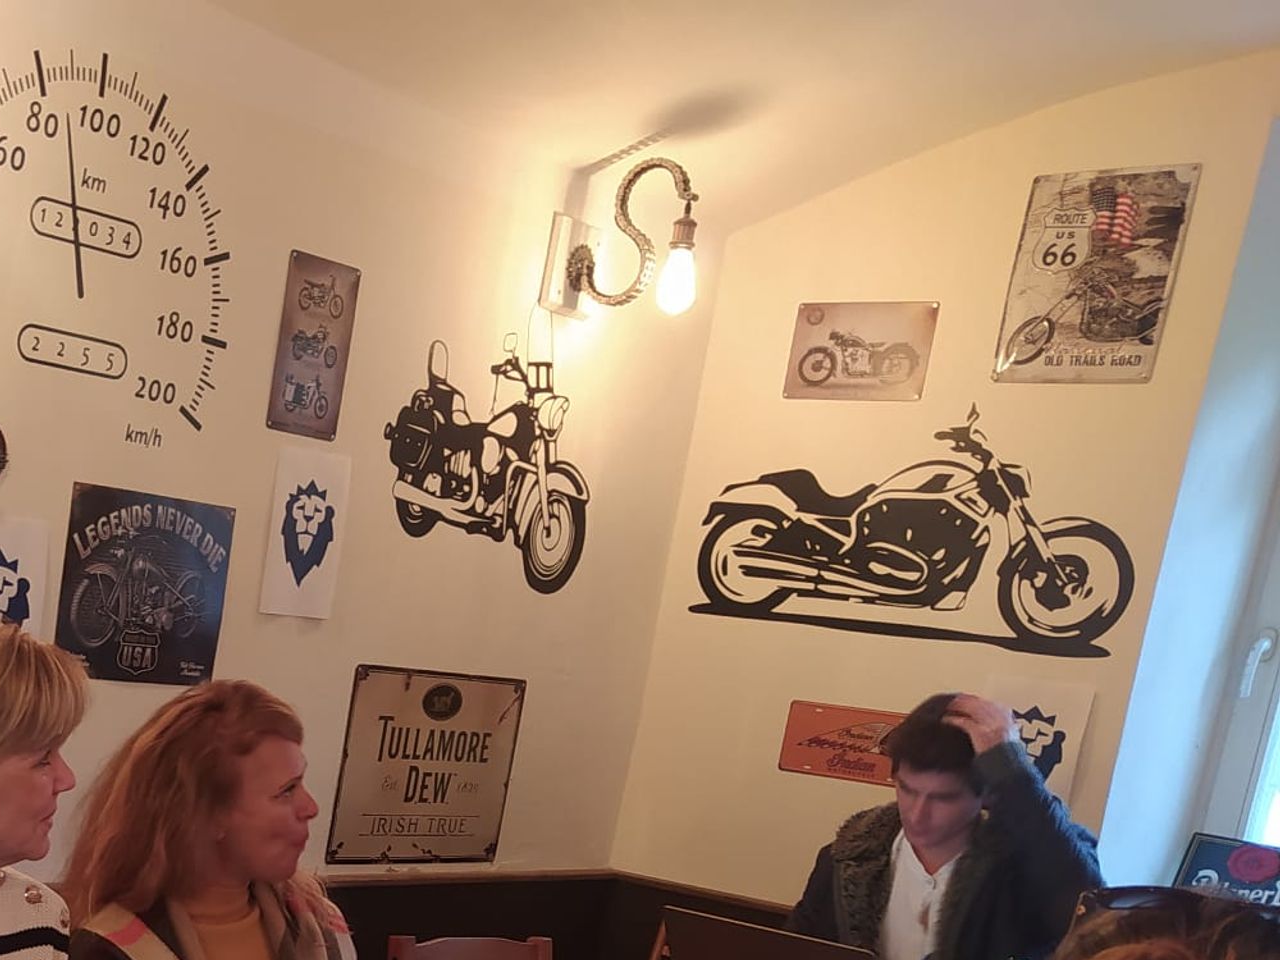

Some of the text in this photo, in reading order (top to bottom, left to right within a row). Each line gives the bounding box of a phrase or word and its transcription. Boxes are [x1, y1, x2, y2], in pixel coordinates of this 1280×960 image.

[26, 101, 59, 138] 80
[78, 104, 121, 138] 100
[128, 134, 166, 166] 120
[81, 168, 107, 194] km
[148, 187, 186, 220] 140
[1052, 212, 1089, 225] ROUTE
[159, 246, 197, 278] 160
[1042, 243, 1077, 267] 66
[156, 311, 194, 343] 180
[1044, 354, 1142, 367] OLD TRAILS ROAD
[135, 376, 176, 405] 200
[124, 424, 162, 448] km/h
[73, 504, 226, 573] LEGENDS NEVER DIE
[122, 645, 151, 668] USA
[377, 715, 492, 763] TULLAMORE
[370, 817, 467, 835] IRISH TRUE
